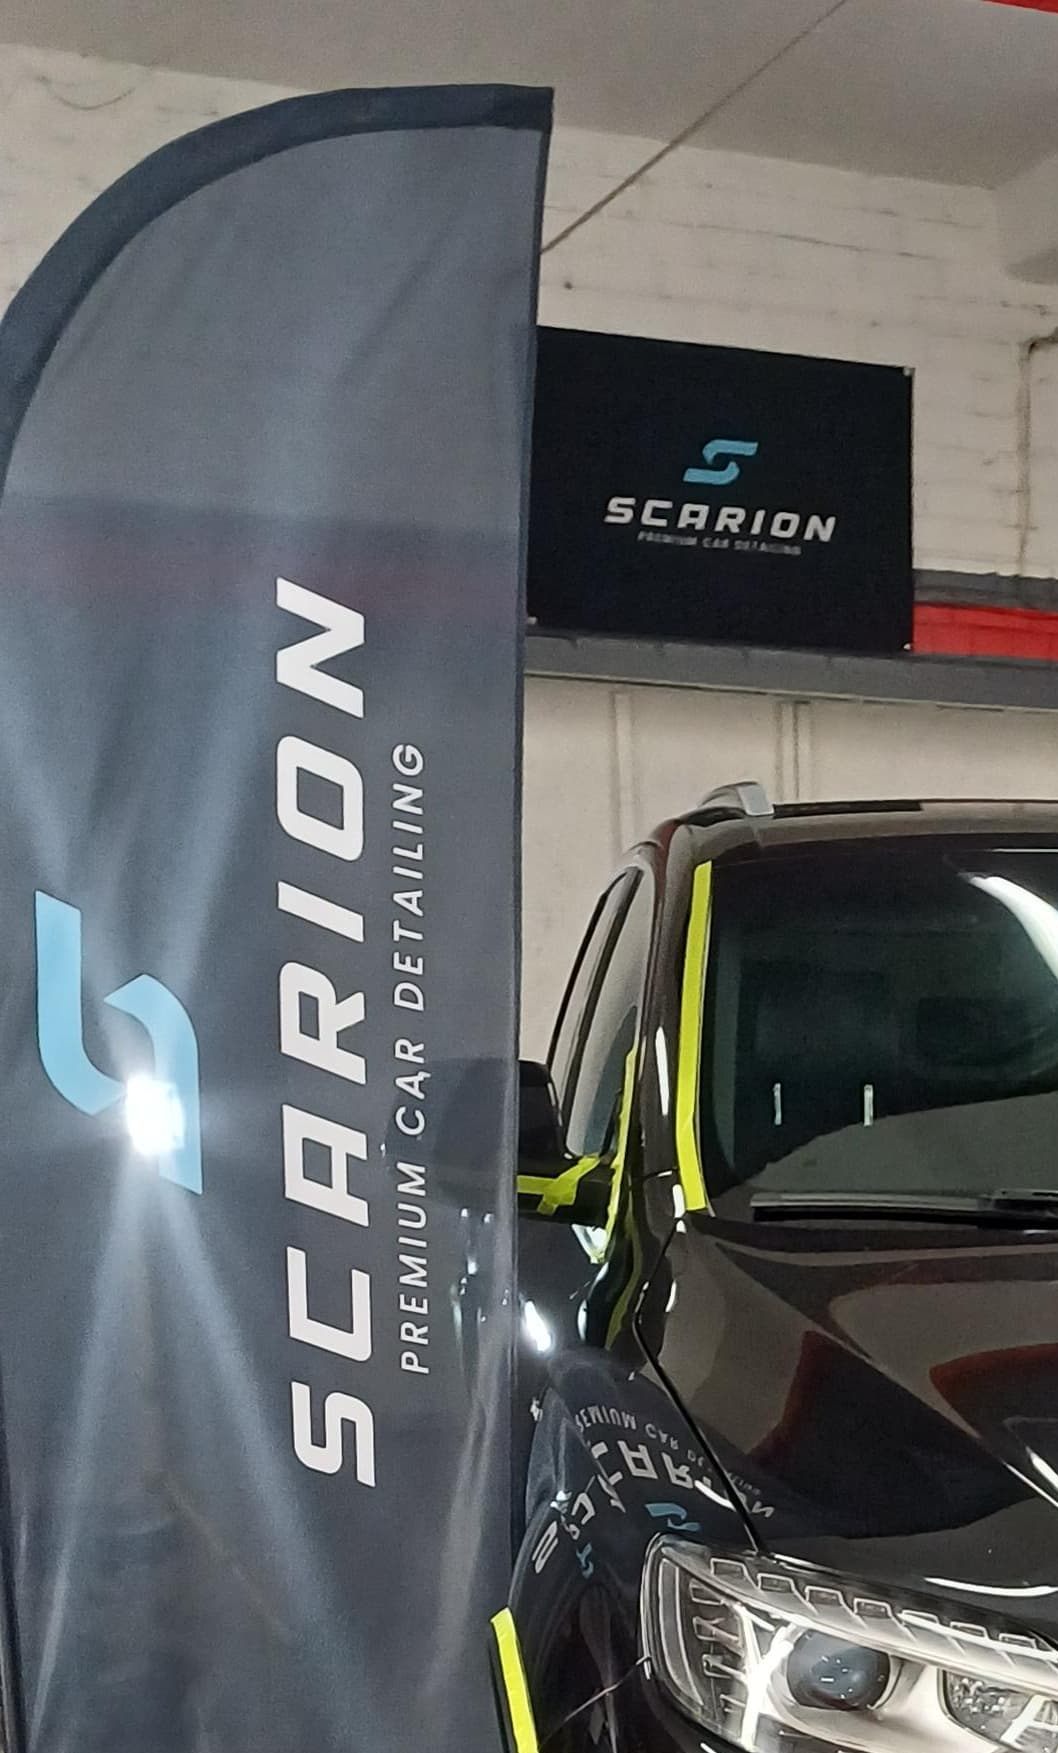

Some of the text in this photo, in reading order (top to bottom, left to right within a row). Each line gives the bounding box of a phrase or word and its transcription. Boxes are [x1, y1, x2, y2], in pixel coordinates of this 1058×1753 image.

[604, 496, 836, 542] SCARION
[276, 577, 376, 1488] SCARION
[393, 744, 429, 1375] PREMIUM CAR DETAILING
